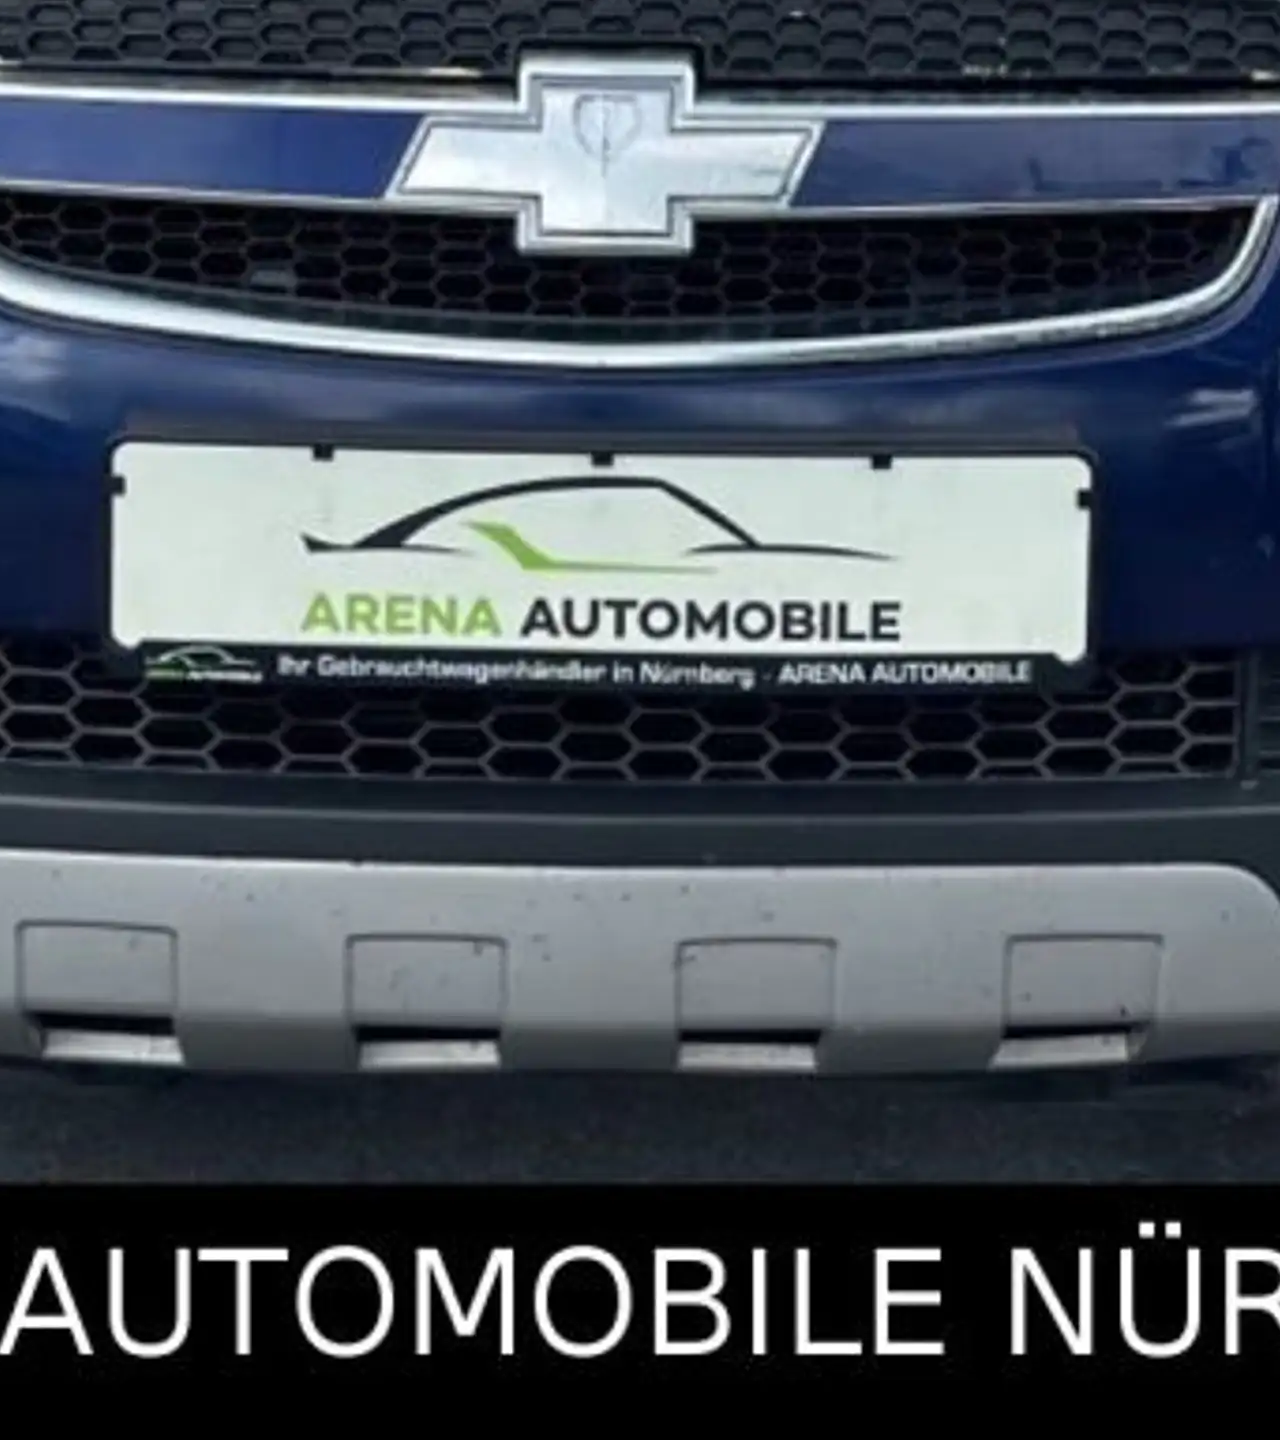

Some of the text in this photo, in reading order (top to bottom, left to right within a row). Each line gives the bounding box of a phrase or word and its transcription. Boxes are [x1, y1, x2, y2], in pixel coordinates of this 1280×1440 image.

[300, 592, 902, 642] ARENA AUTOMOBILE
[277, 653, 311, 677] Ihr
[317, 654, 607, 684] Gebrauchtwagenhändler
[613, 661, 634, 683] in
[639, 661, 756, 691] Nürnberg
[777, 662, 866, 685] ARENA
[872, 661, 1034, 685] AUTOMOBILE
